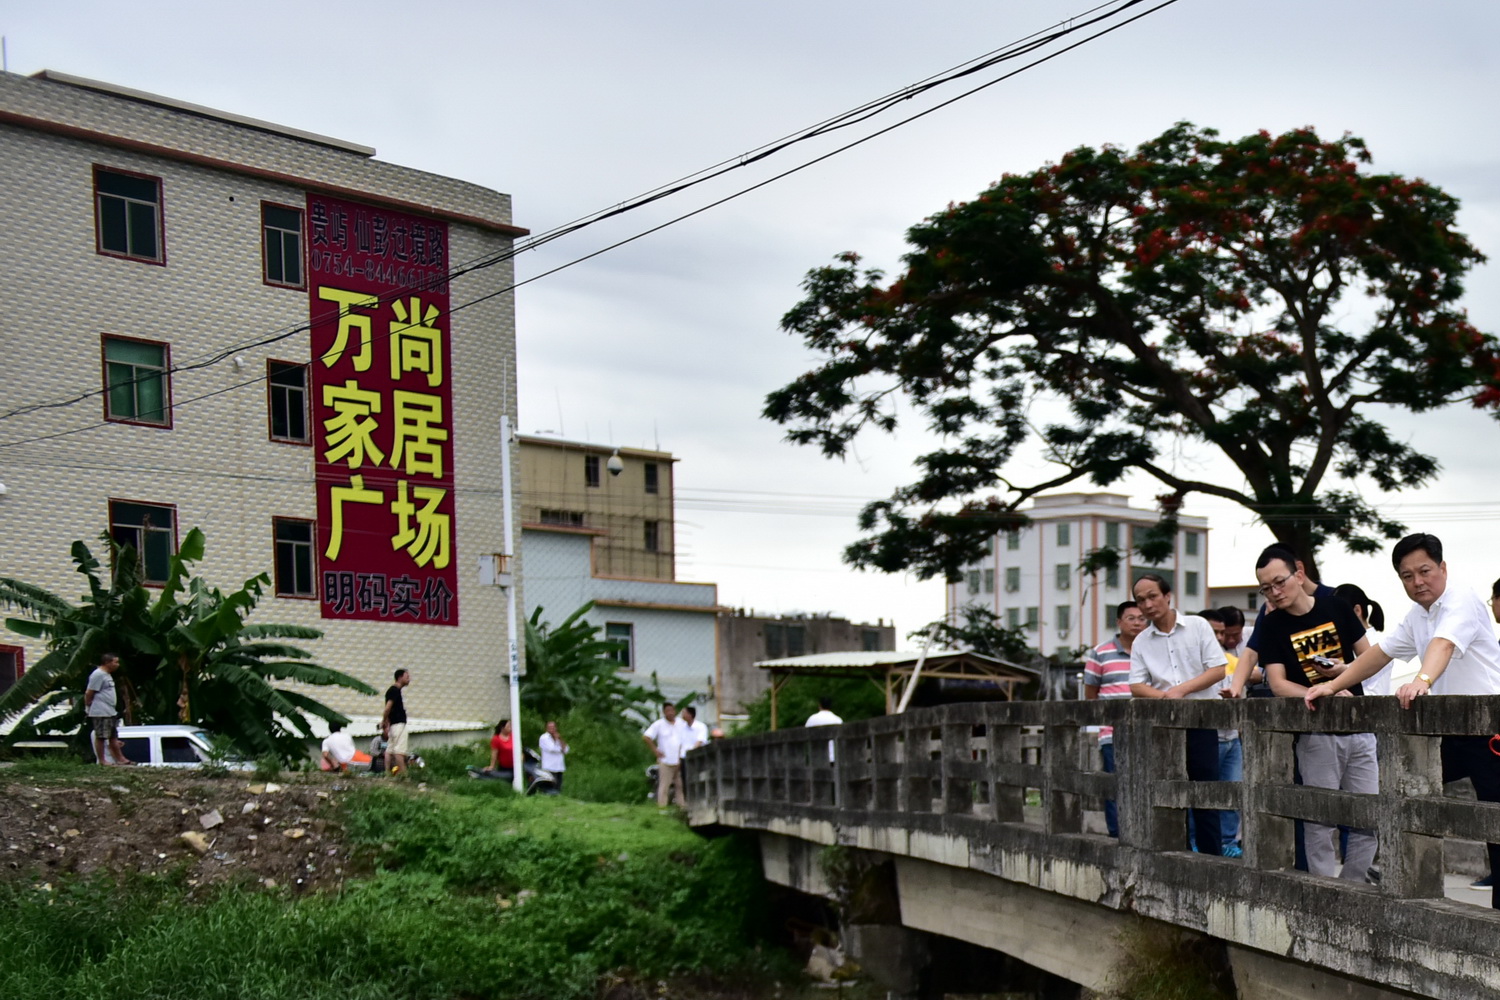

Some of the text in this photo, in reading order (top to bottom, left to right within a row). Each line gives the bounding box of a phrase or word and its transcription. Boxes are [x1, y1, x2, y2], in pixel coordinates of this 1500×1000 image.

[311, 200, 444, 271] 贵屿 仙彭过境路
[323, 571, 453, 621] 明码实价
